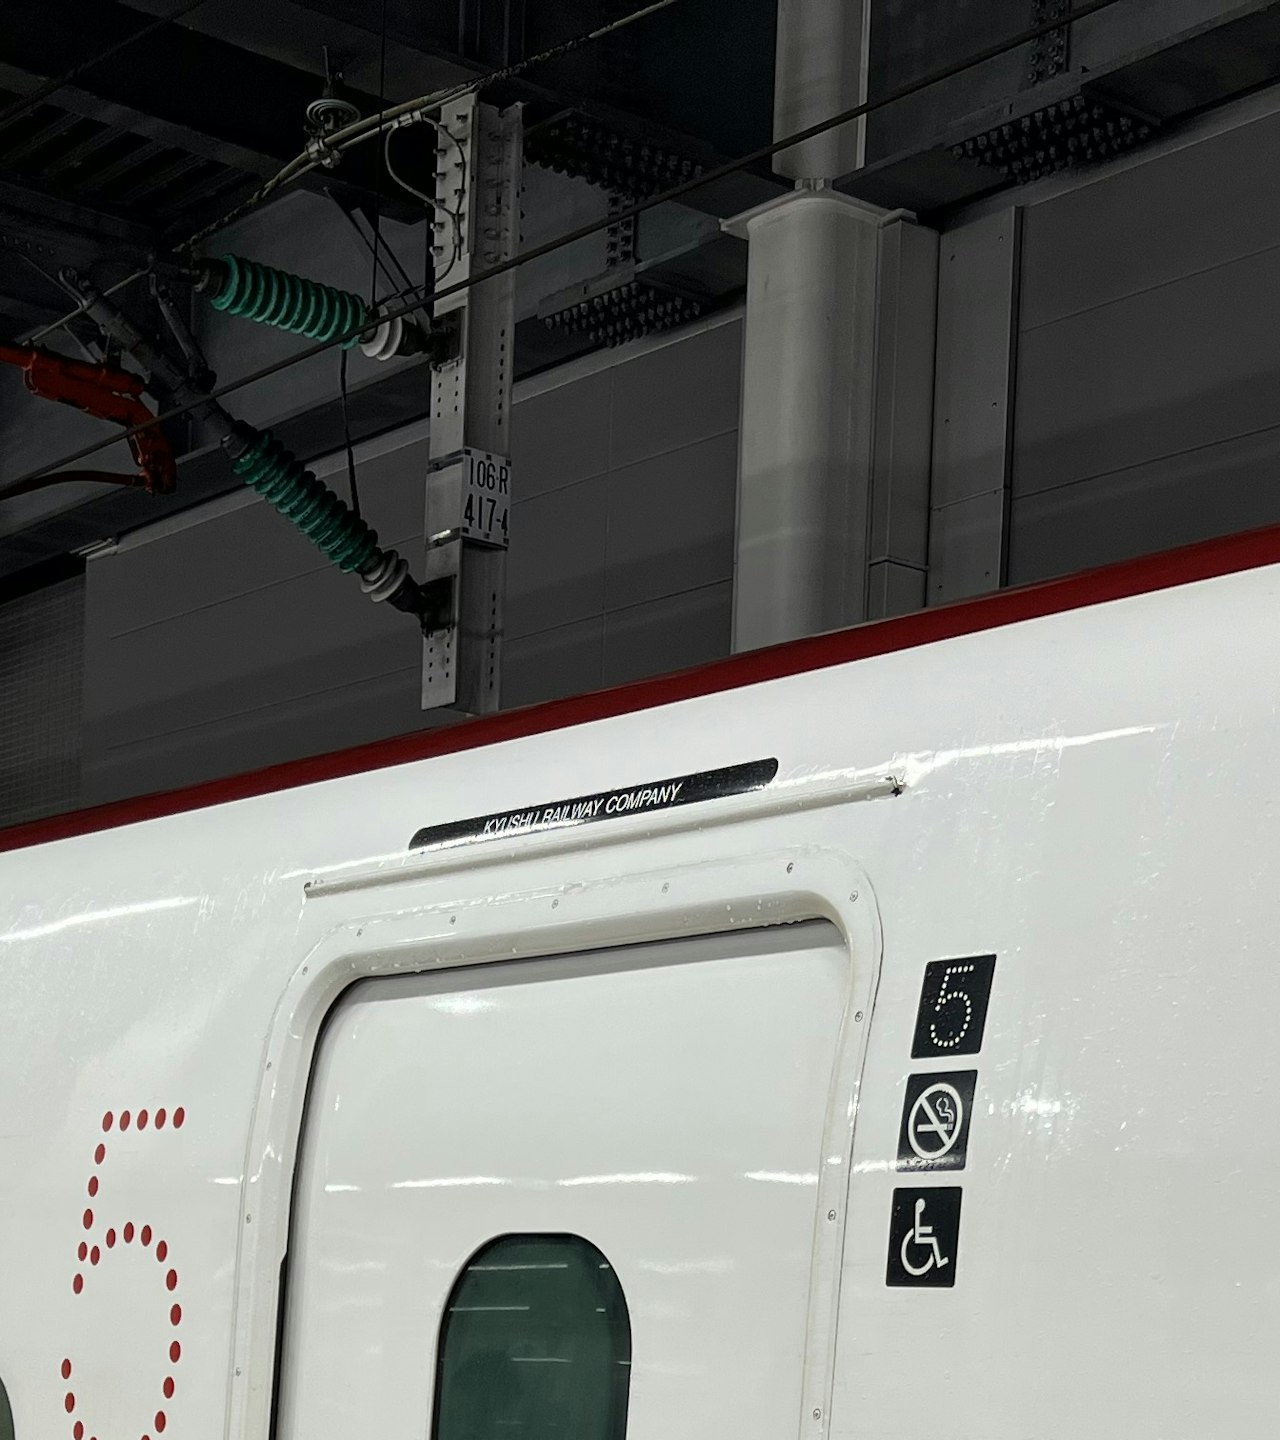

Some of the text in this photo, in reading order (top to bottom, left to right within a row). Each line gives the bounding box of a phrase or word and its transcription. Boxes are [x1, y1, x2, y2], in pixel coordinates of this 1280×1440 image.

[464, 493, 508, 536] 417-4
[483, 782, 683, 834] KYUSHU RAILWAY COMPANY
[930, 964, 975, 1048] 5
